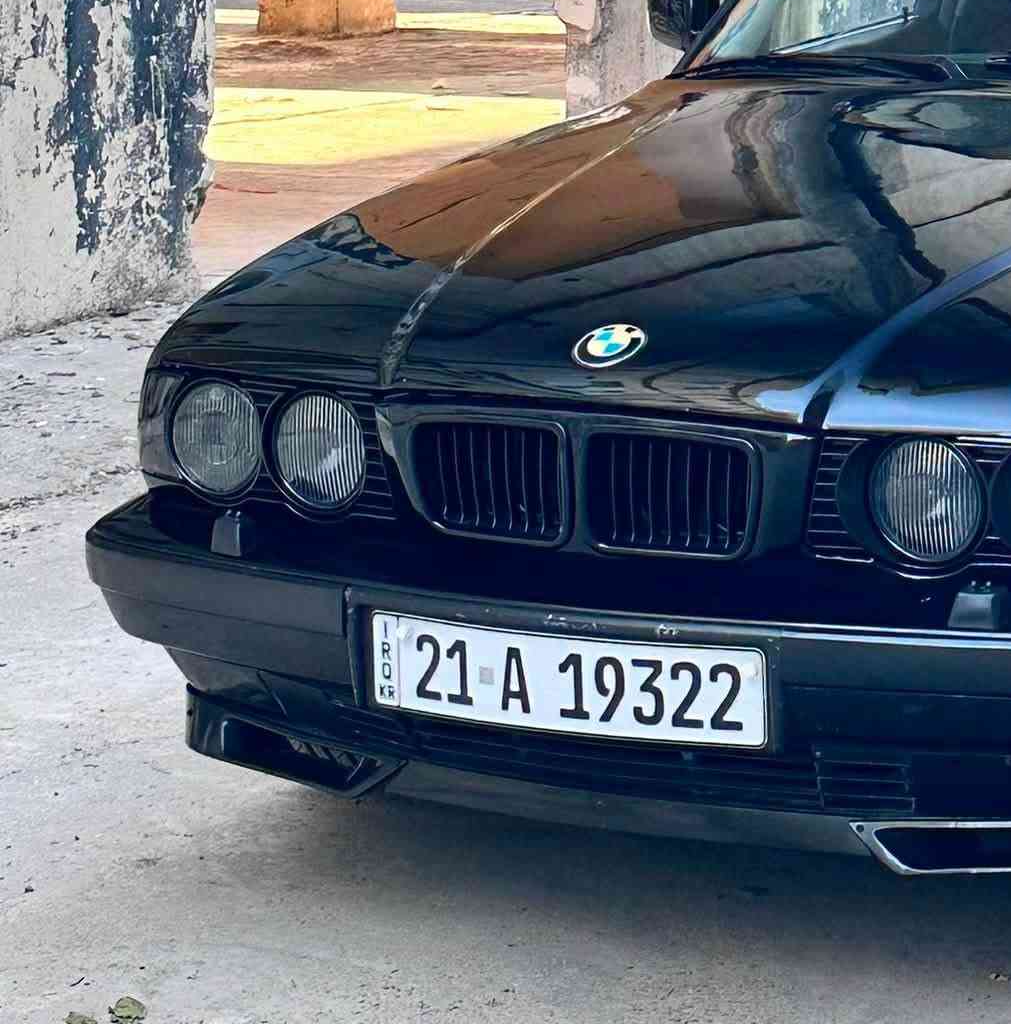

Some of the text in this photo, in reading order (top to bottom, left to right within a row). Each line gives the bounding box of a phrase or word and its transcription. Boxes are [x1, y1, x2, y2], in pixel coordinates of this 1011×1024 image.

[415, 634, 744, 732] 21 A 19322
